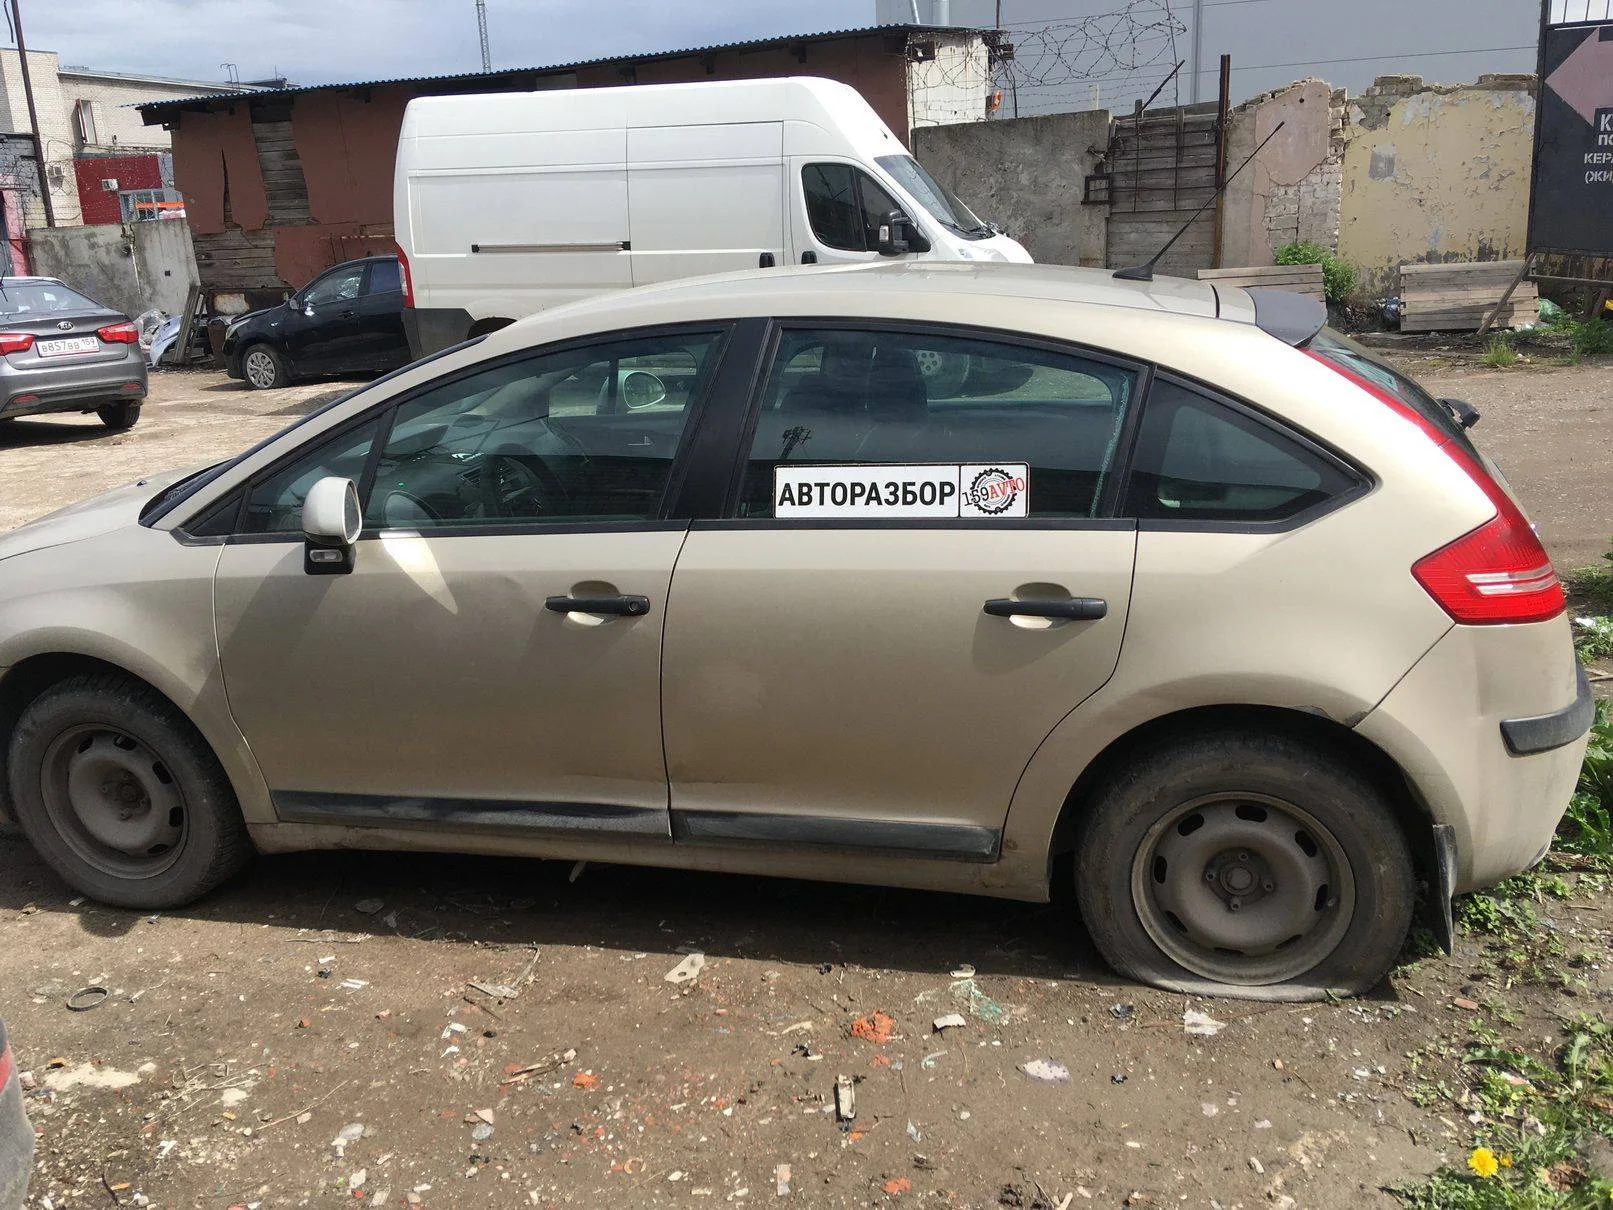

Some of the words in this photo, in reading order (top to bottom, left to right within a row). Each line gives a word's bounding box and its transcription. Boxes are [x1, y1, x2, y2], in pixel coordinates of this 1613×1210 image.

[1600, 113, 1613, 132] К
[1583, 152, 1613, 164] КЕР
[1584, 170, 1613, 184] (ЖИ
[81, 338, 95, 346] 159
[778, 481, 955, 506] АВТОРАЗБОР
